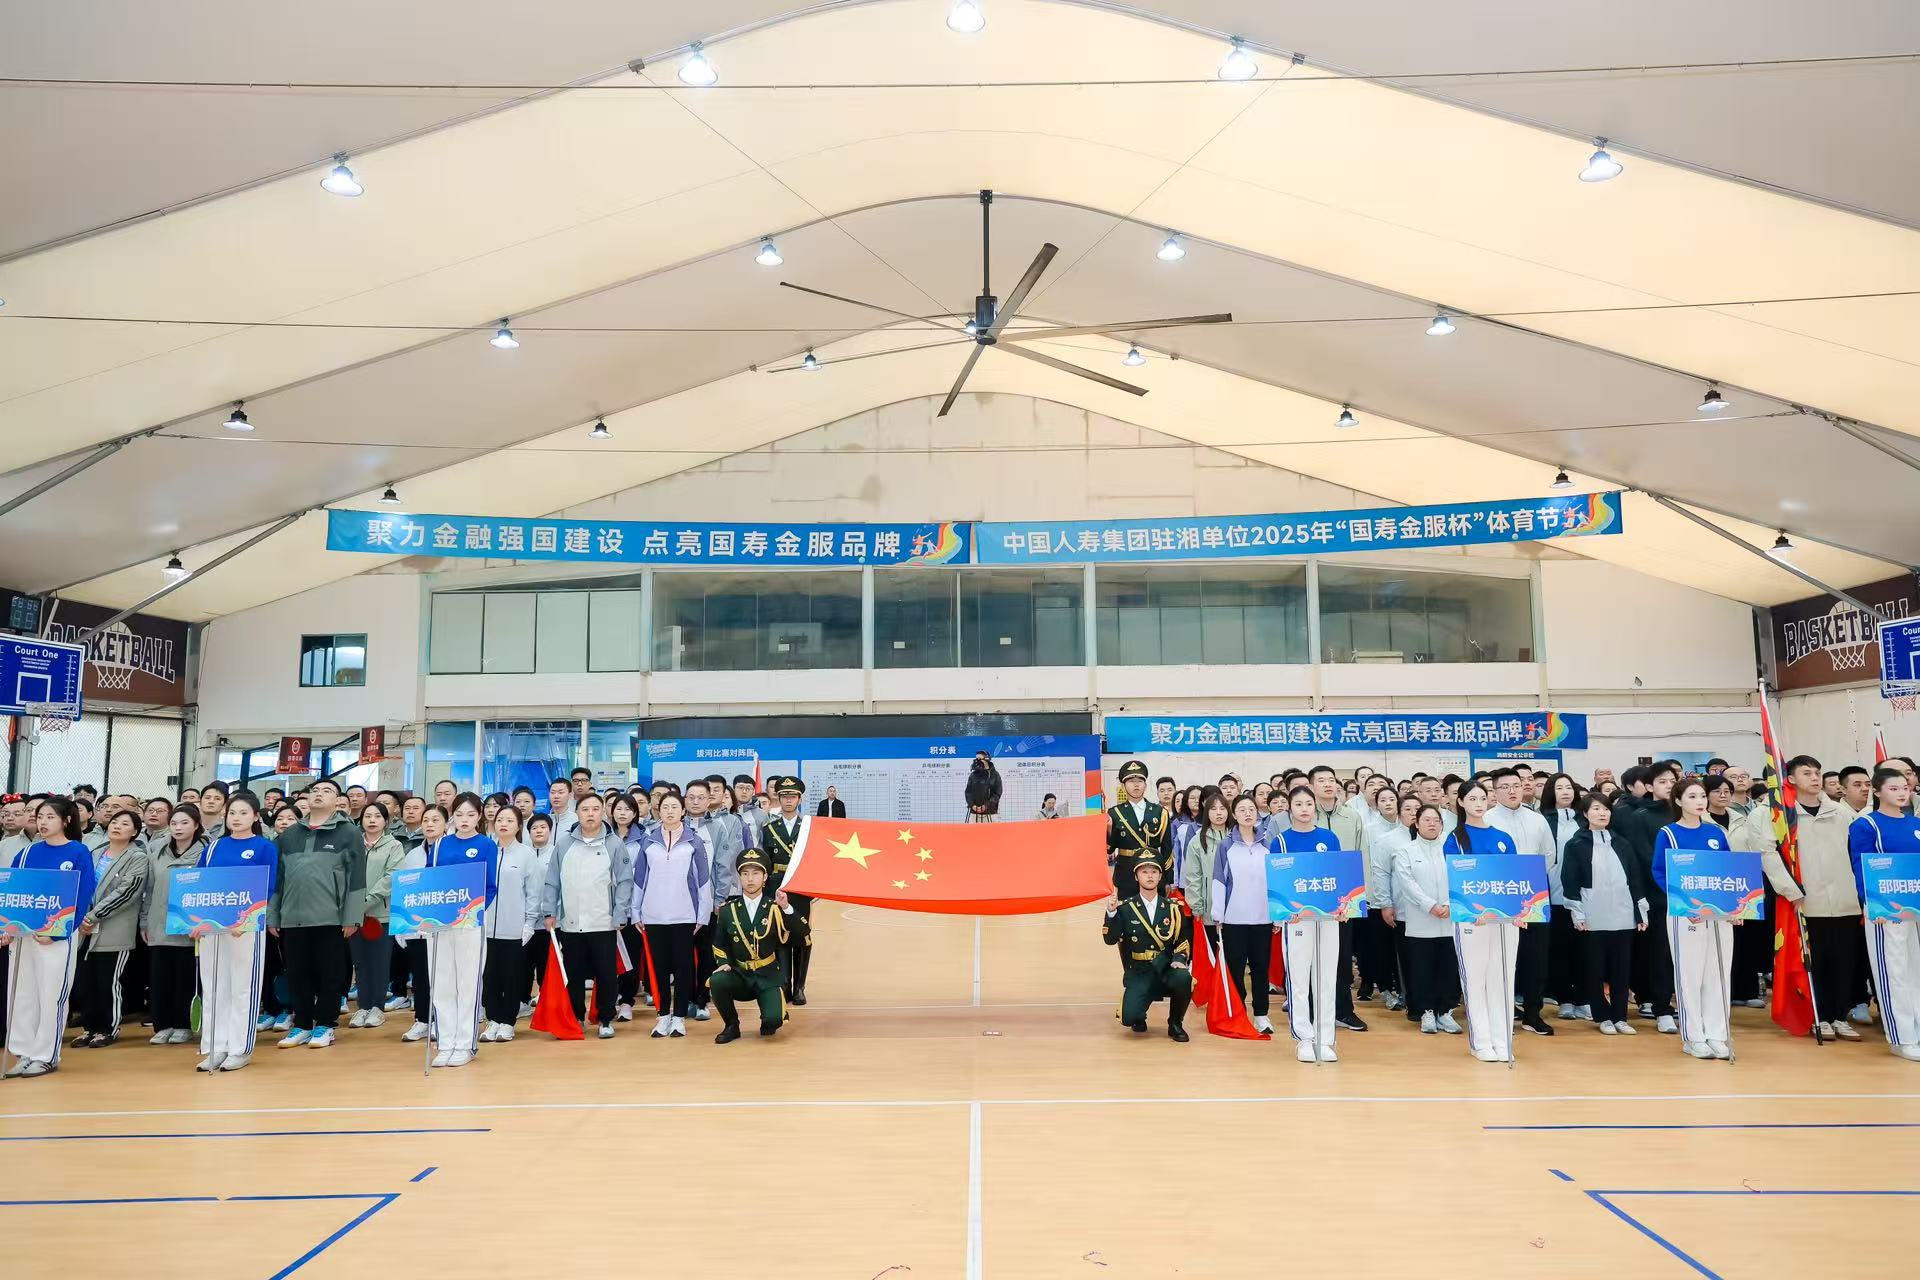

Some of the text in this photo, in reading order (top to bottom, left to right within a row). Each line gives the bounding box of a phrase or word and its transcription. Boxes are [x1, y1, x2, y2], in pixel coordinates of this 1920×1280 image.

[366, 519, 902, 559] 聚力金融强国建设 点亮国寿金服品牌
[1002, 508, 1561, 554] 中国人寿集团驻湘单位2025年“国寿金服杯”体育节
[14, 645, 59, 659] Court One
[1149, 718, 1523, 745] 聚力金融强国建设 点亮国寿金服品牌
[929, 745, 957, 755] 积分表
[1294, 877, 1337, 893] 省本部
[1461, 880, 1535, 896] 长沙联合队
[1680, 875, 1750, 892] 湘潭联合队
[181, 890, 254, 908] 衡阳联合队
[403, 888, 472, 908] 株洲联合队
